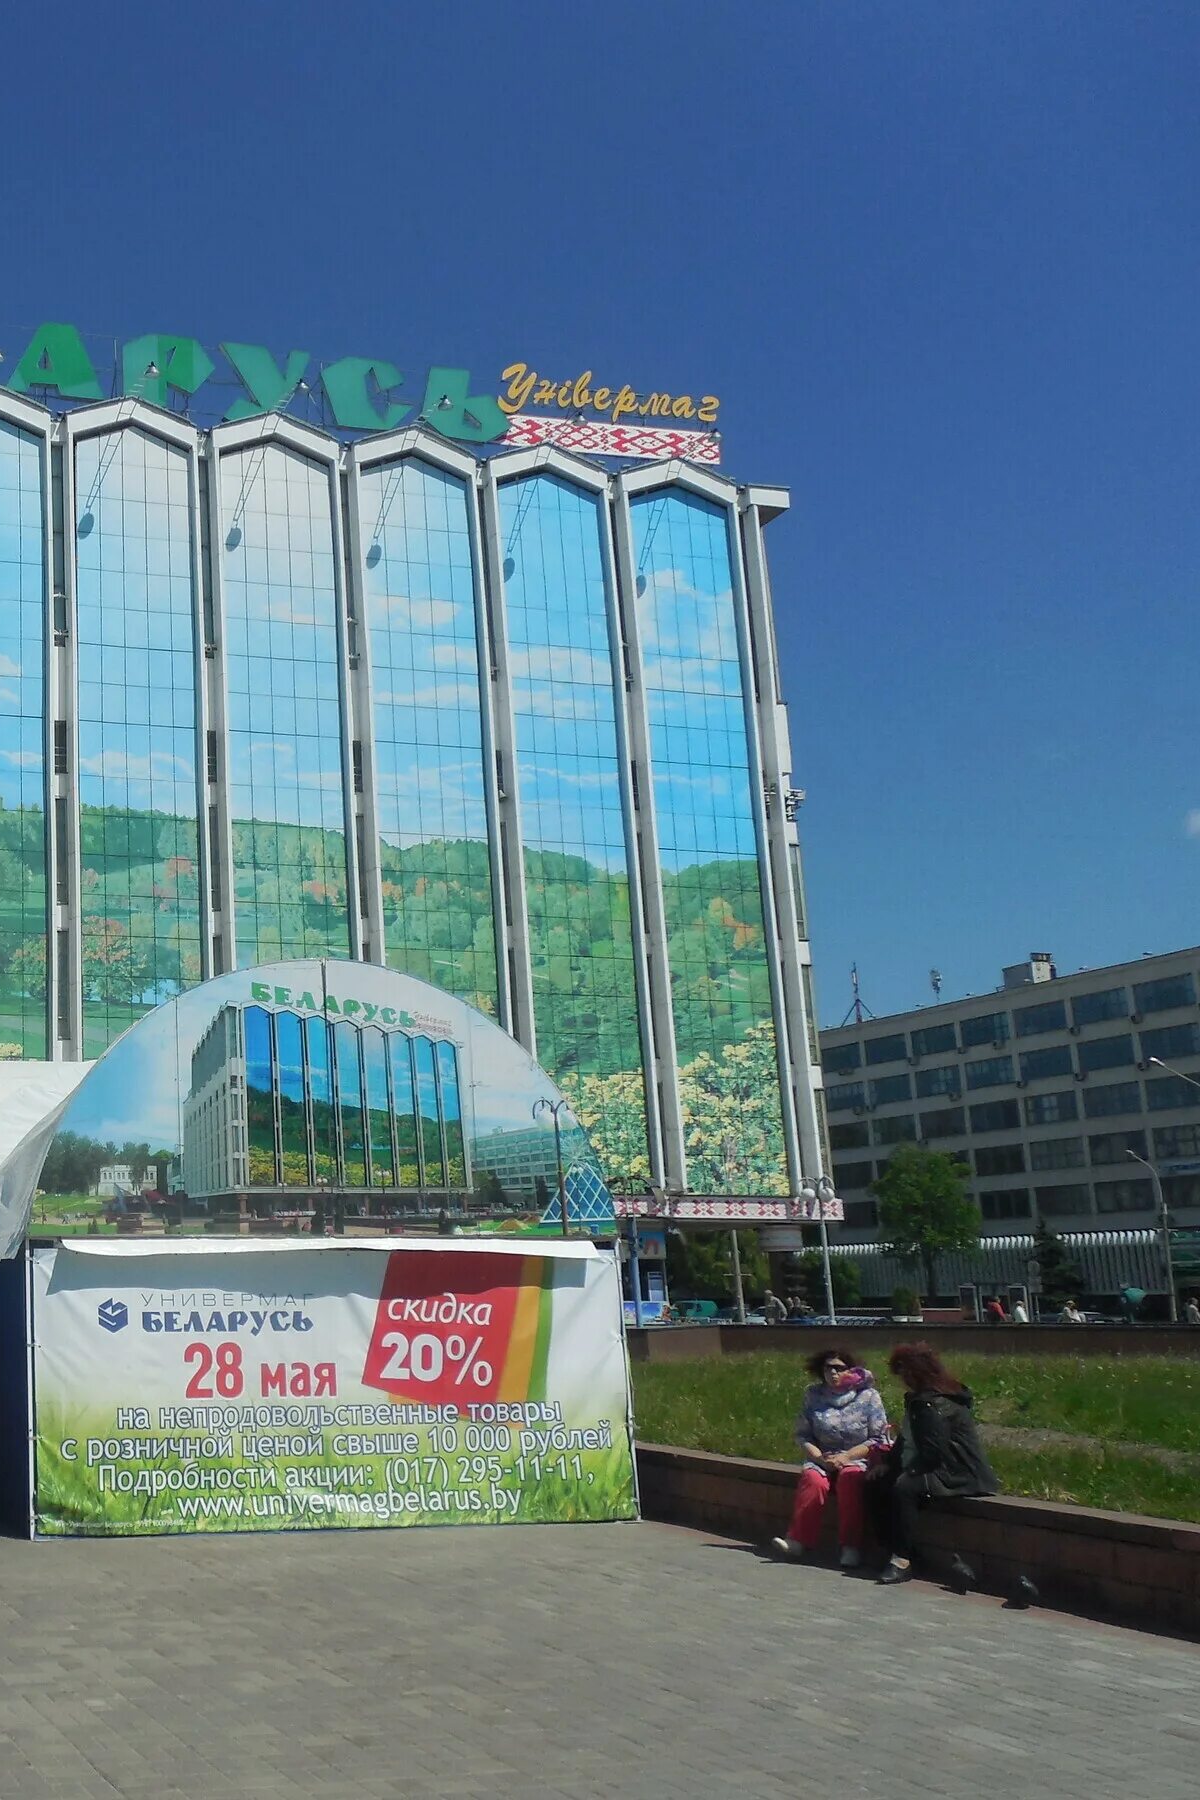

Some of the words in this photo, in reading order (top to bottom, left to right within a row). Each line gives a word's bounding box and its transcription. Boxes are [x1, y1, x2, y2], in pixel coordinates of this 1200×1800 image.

[498, 363, 720, 426] Універмаг
[251, 981, 416, 1029] БЕЛАРУСЬ
[140, 1292, 316, 1308] УНИВЕРМАГ
[387, 1291, 493, 1326] скидка
[141, 1310, 315, 1337] БЕЛАРУСЬ
[183, 1341, 244, 1399] 28
[260, 1361, 338, 1398] мая
[379, 1331, 493, 1387] 20%
[116, 1407, 150, 1430] на
[159, 1403, 459, 1435] непродовольственные
[467, 1400, 562, 1428] товары
[61, 1437, 79, 1460] с
[86, 1425, 233, 1467] розничной
[242, 1424, 324, 1462] ценой
[333, 1432, 419, 1456] свыше
[428, 1426, 458, 1453] 10
[464, 1425, 512, 1453] 000
[519, 1419, 613, 1458] рублей
[99, 1462, 278, 1498] Подробности
[284, 1464, 374, 1493] акции:
[385, 1456, 450, 1490] (017)
[457, 1453, 595, 1485] 295-11-11,
[176, 1482, 523, 1520] www.univermagbelarus.by
